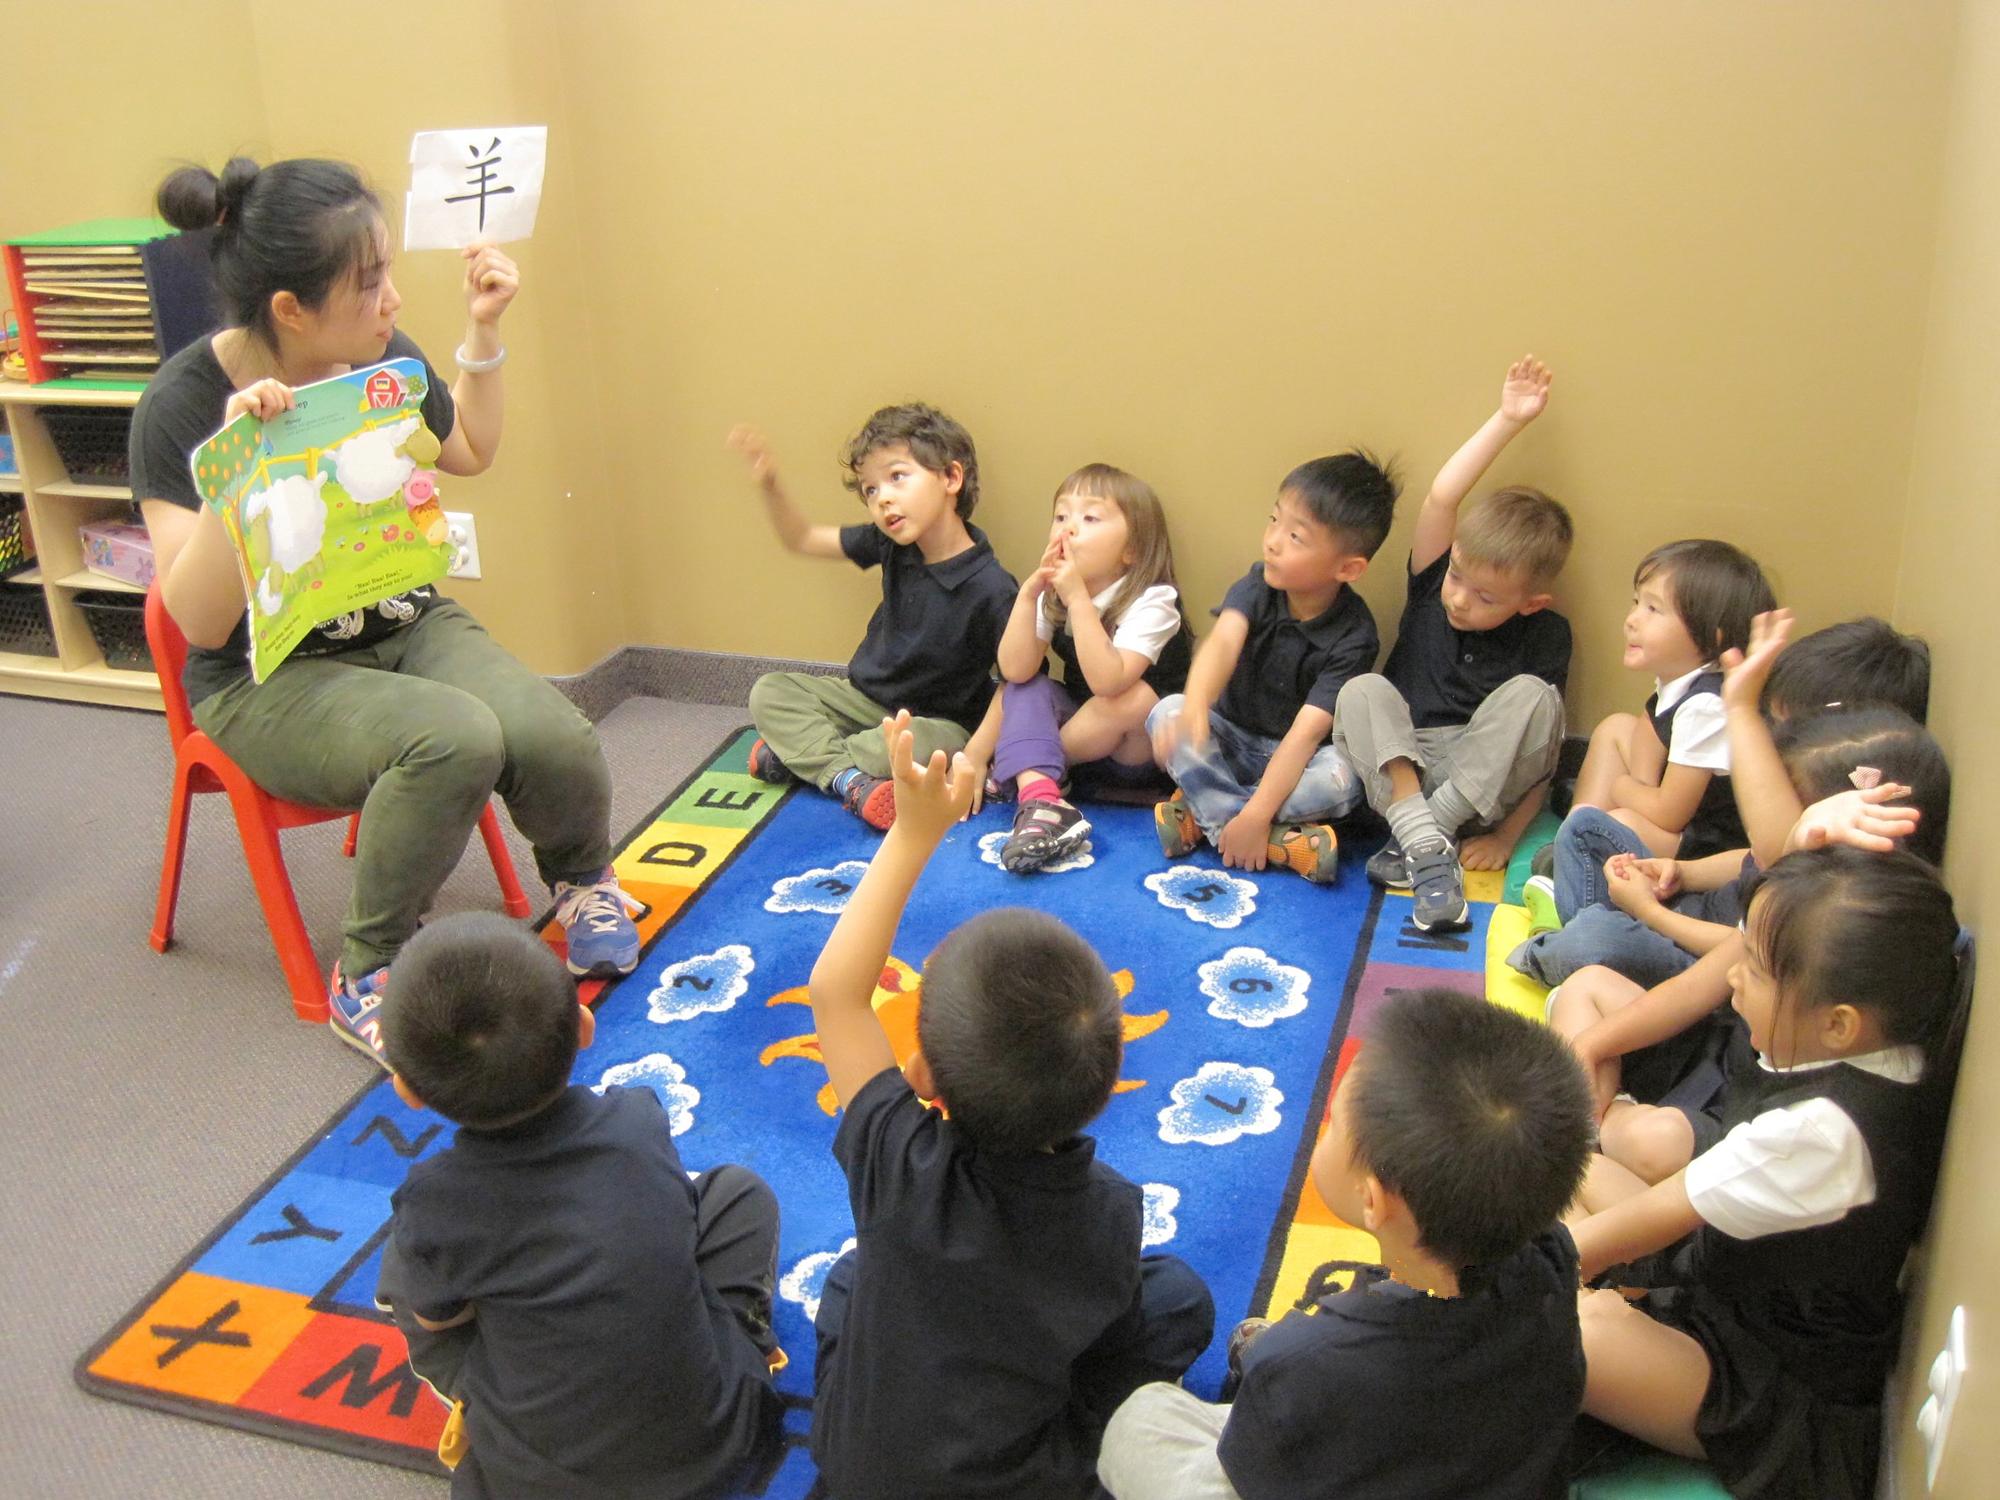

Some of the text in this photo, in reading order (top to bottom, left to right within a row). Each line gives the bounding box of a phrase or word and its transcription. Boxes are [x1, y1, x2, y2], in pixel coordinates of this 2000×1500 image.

[444, 136, 515, 233] 羊
[694, 788, 766, 811] E
[637, 842, 708, 868] D
[814, 879, 852, 896] 3
[1182, 883, 1227, 905] 5
[672, 974, 714, 991] 2
[1205, 1093, 1247, 1115] 7
[351, 1115, 445, 1158] Z
[248, 1203, 344, 1246] Y
[150, 1299, 252, 1370] X
